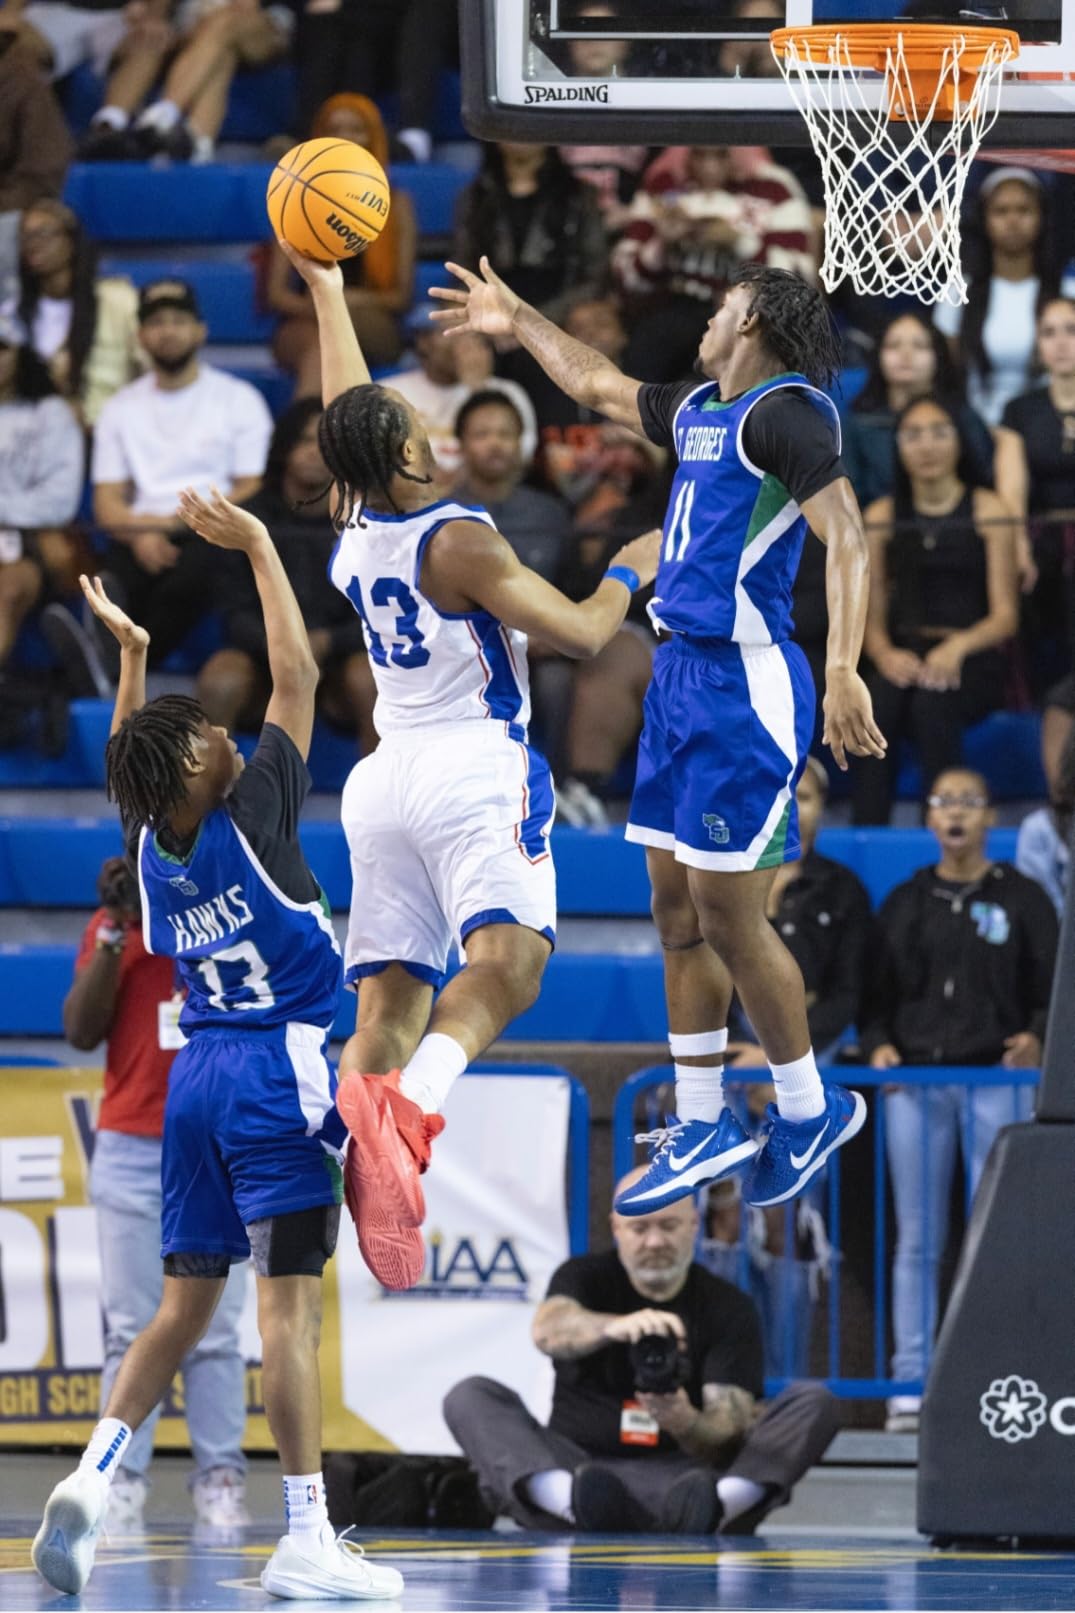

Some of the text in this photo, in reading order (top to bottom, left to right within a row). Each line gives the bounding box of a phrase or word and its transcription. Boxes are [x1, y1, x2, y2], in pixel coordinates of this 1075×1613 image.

[524, 84, 608, 104] SPALDING
[326, 212, 370, 254] ilson
[683, 426, 728, 462] GEORGES
[664, 479, 696, 563] 11
[345, 575, 431, 670] 13
[167, 884, 254, 953] HAWKS
[198, 940, 276, 1012] 13
[427, 1231, 528, 1283] IAA
